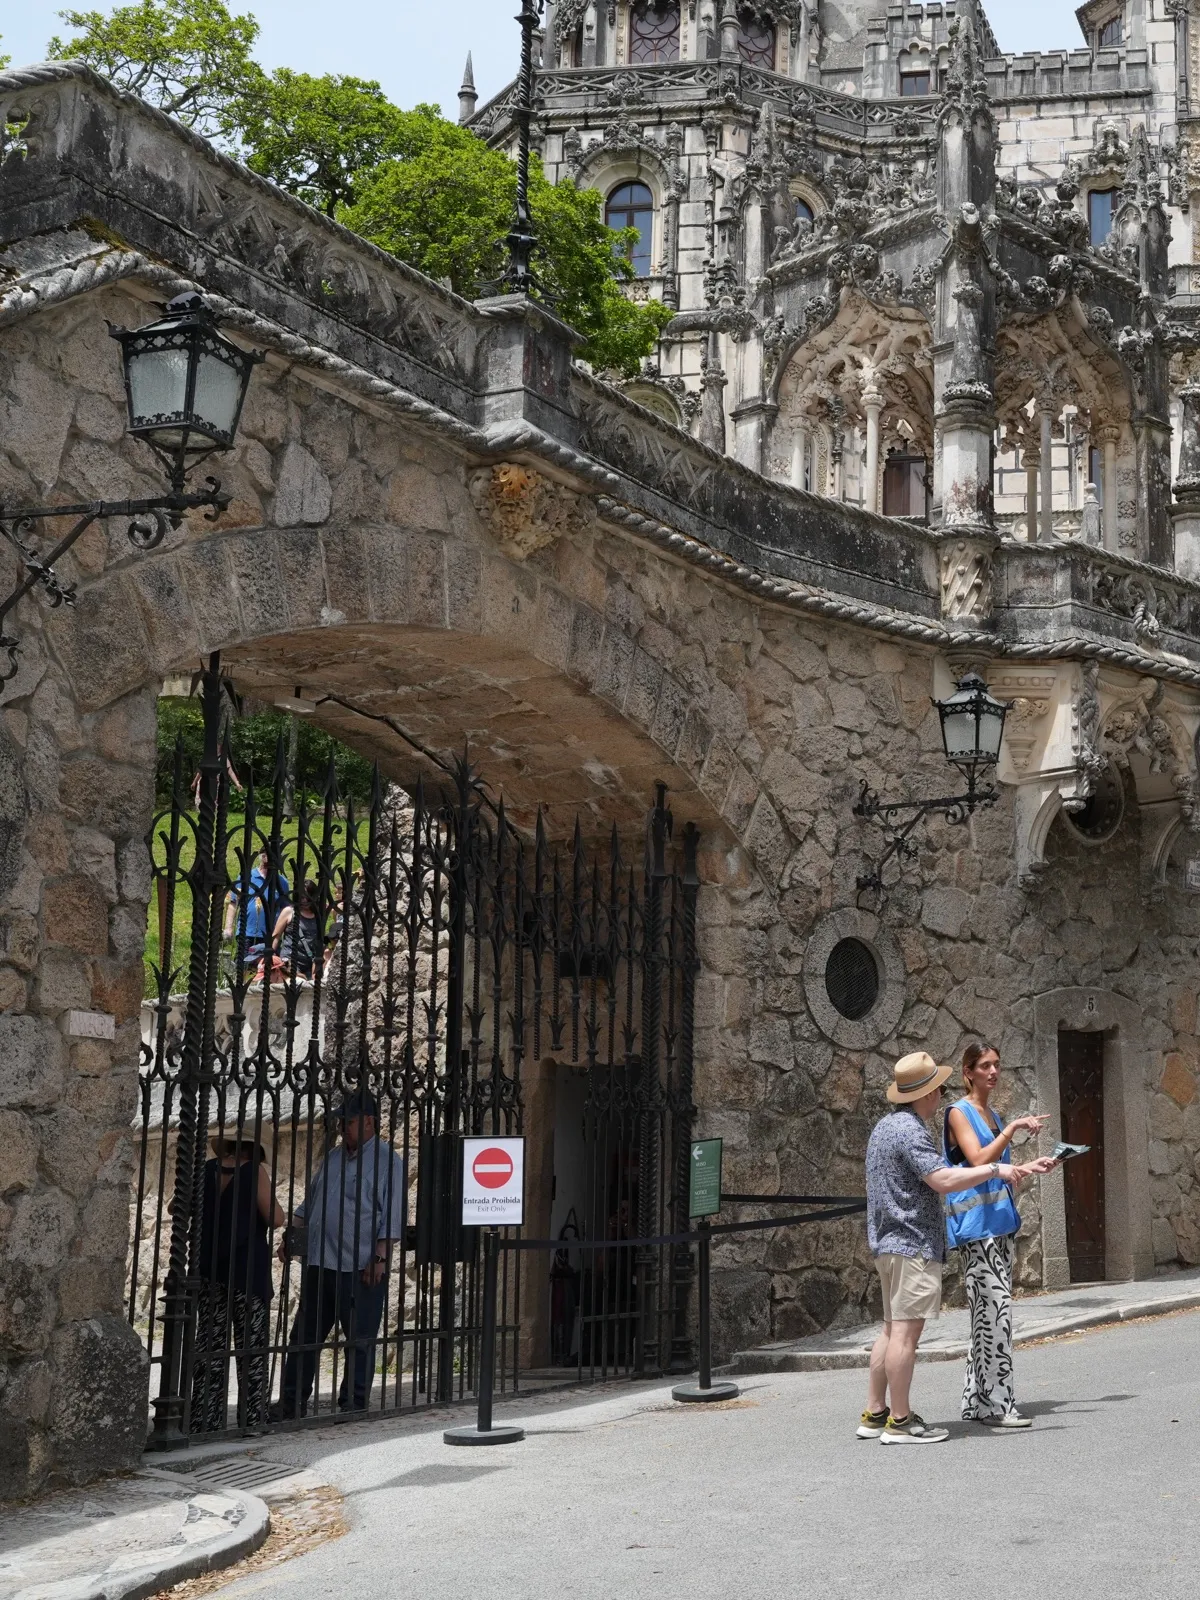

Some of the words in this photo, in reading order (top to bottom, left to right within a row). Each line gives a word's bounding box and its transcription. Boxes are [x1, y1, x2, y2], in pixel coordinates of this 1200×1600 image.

[463, 1196, 490, 1204] Entrada
[491, 1196, 521, 1204] Proibida
[490, 1205, 507, 1213] Only
